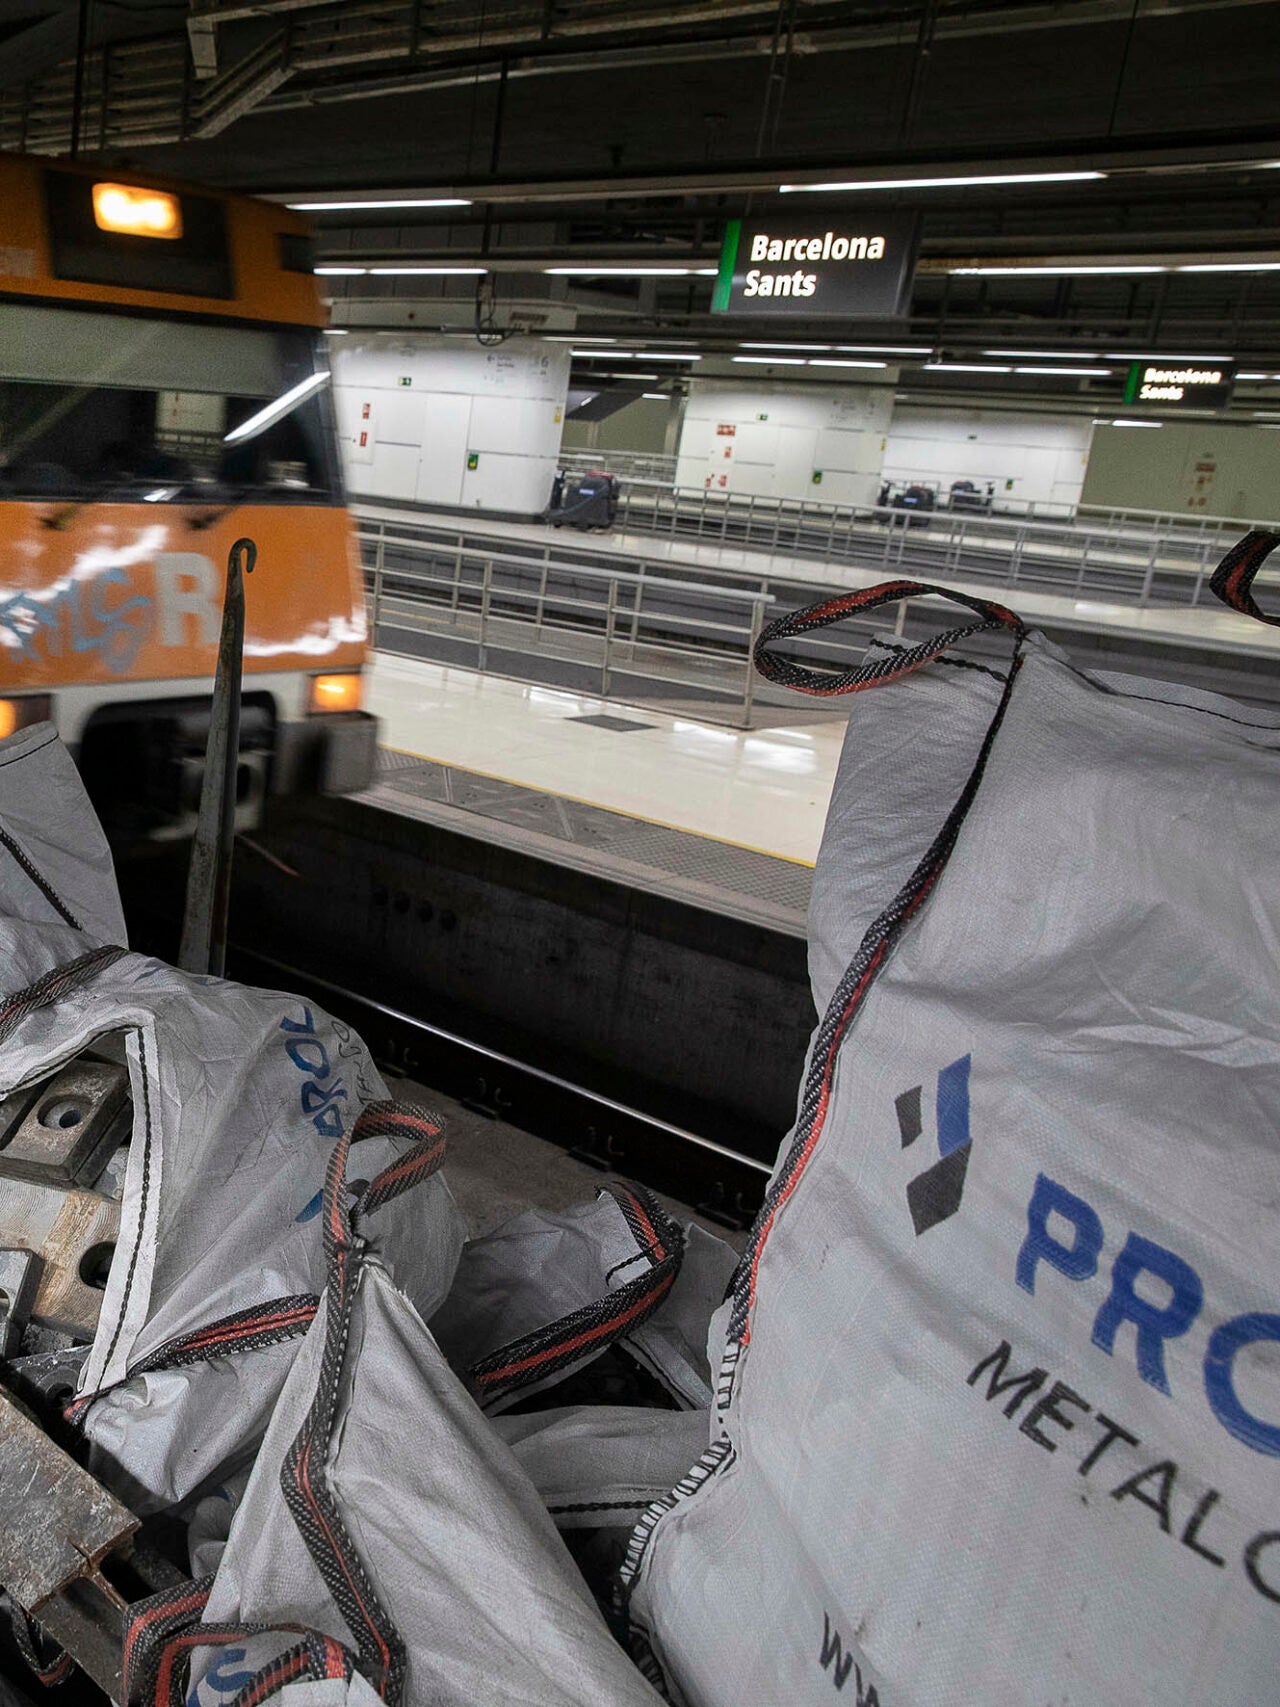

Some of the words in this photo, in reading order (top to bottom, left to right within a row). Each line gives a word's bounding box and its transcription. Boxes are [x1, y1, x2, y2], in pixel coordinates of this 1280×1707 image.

[750, 231, 886, 262] Barcelona
[743, 268, 817, 298] Sants
[1143, 367, 1222, 384] Barcelona
[1139, 384, 1184, 400] Sants
[154, 551, 222, 647] R
